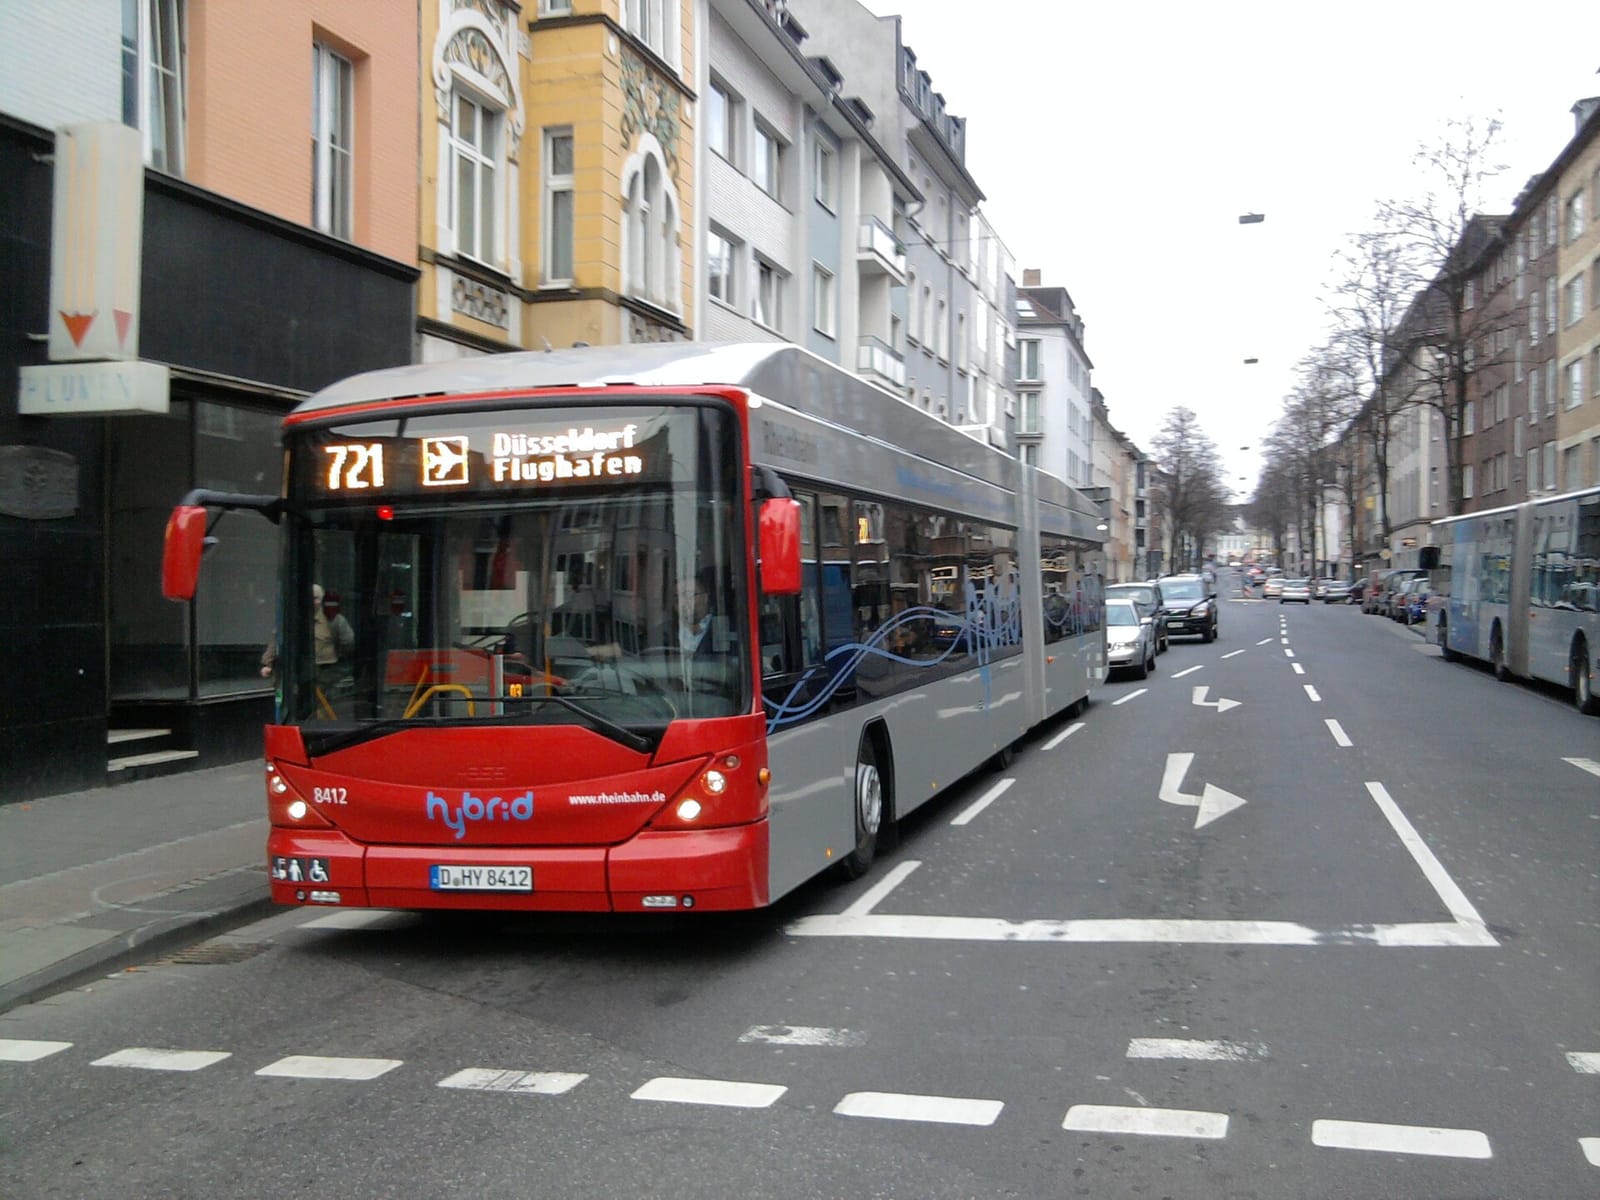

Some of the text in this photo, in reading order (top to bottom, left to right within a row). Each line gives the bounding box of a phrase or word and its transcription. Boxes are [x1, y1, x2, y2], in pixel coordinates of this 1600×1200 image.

[493, 424, 638, 457] Düsseldorf
[324, 443, 385, 490] 721
[493, 454, 643, 482] Flughafen
[313, 787, 348, 805] 8412
[568, 791, 666, 805] www.rheinbahn.de
[487, 869, 529, 887] 8412
